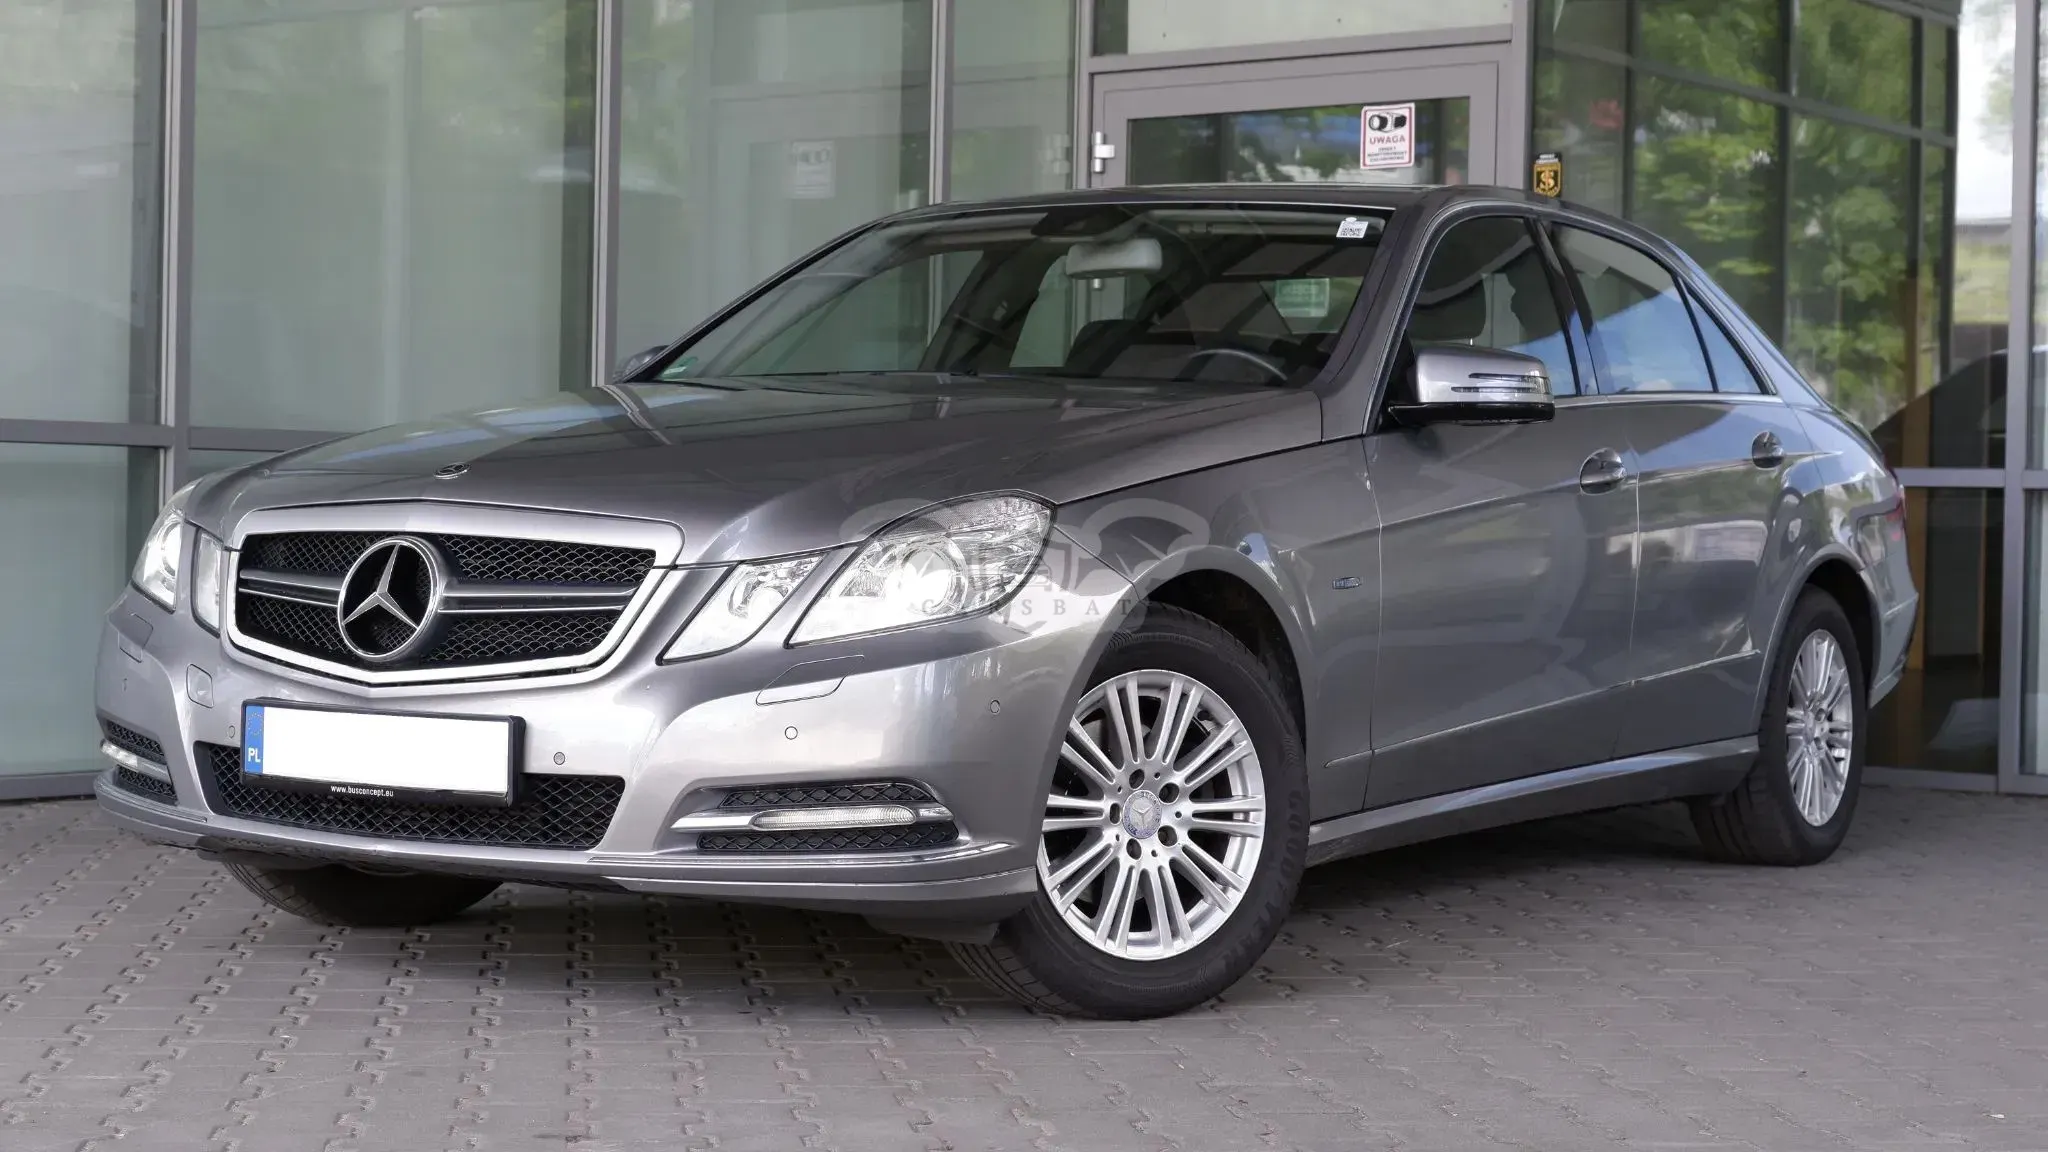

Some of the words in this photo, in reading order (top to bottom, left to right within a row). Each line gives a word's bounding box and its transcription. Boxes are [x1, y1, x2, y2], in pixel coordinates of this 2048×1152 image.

[1369, 134, 1406, 145] UWAGA
[248, 747, 261, 763] PL
[330, 785, 394, 798] www.busconcept.eu
